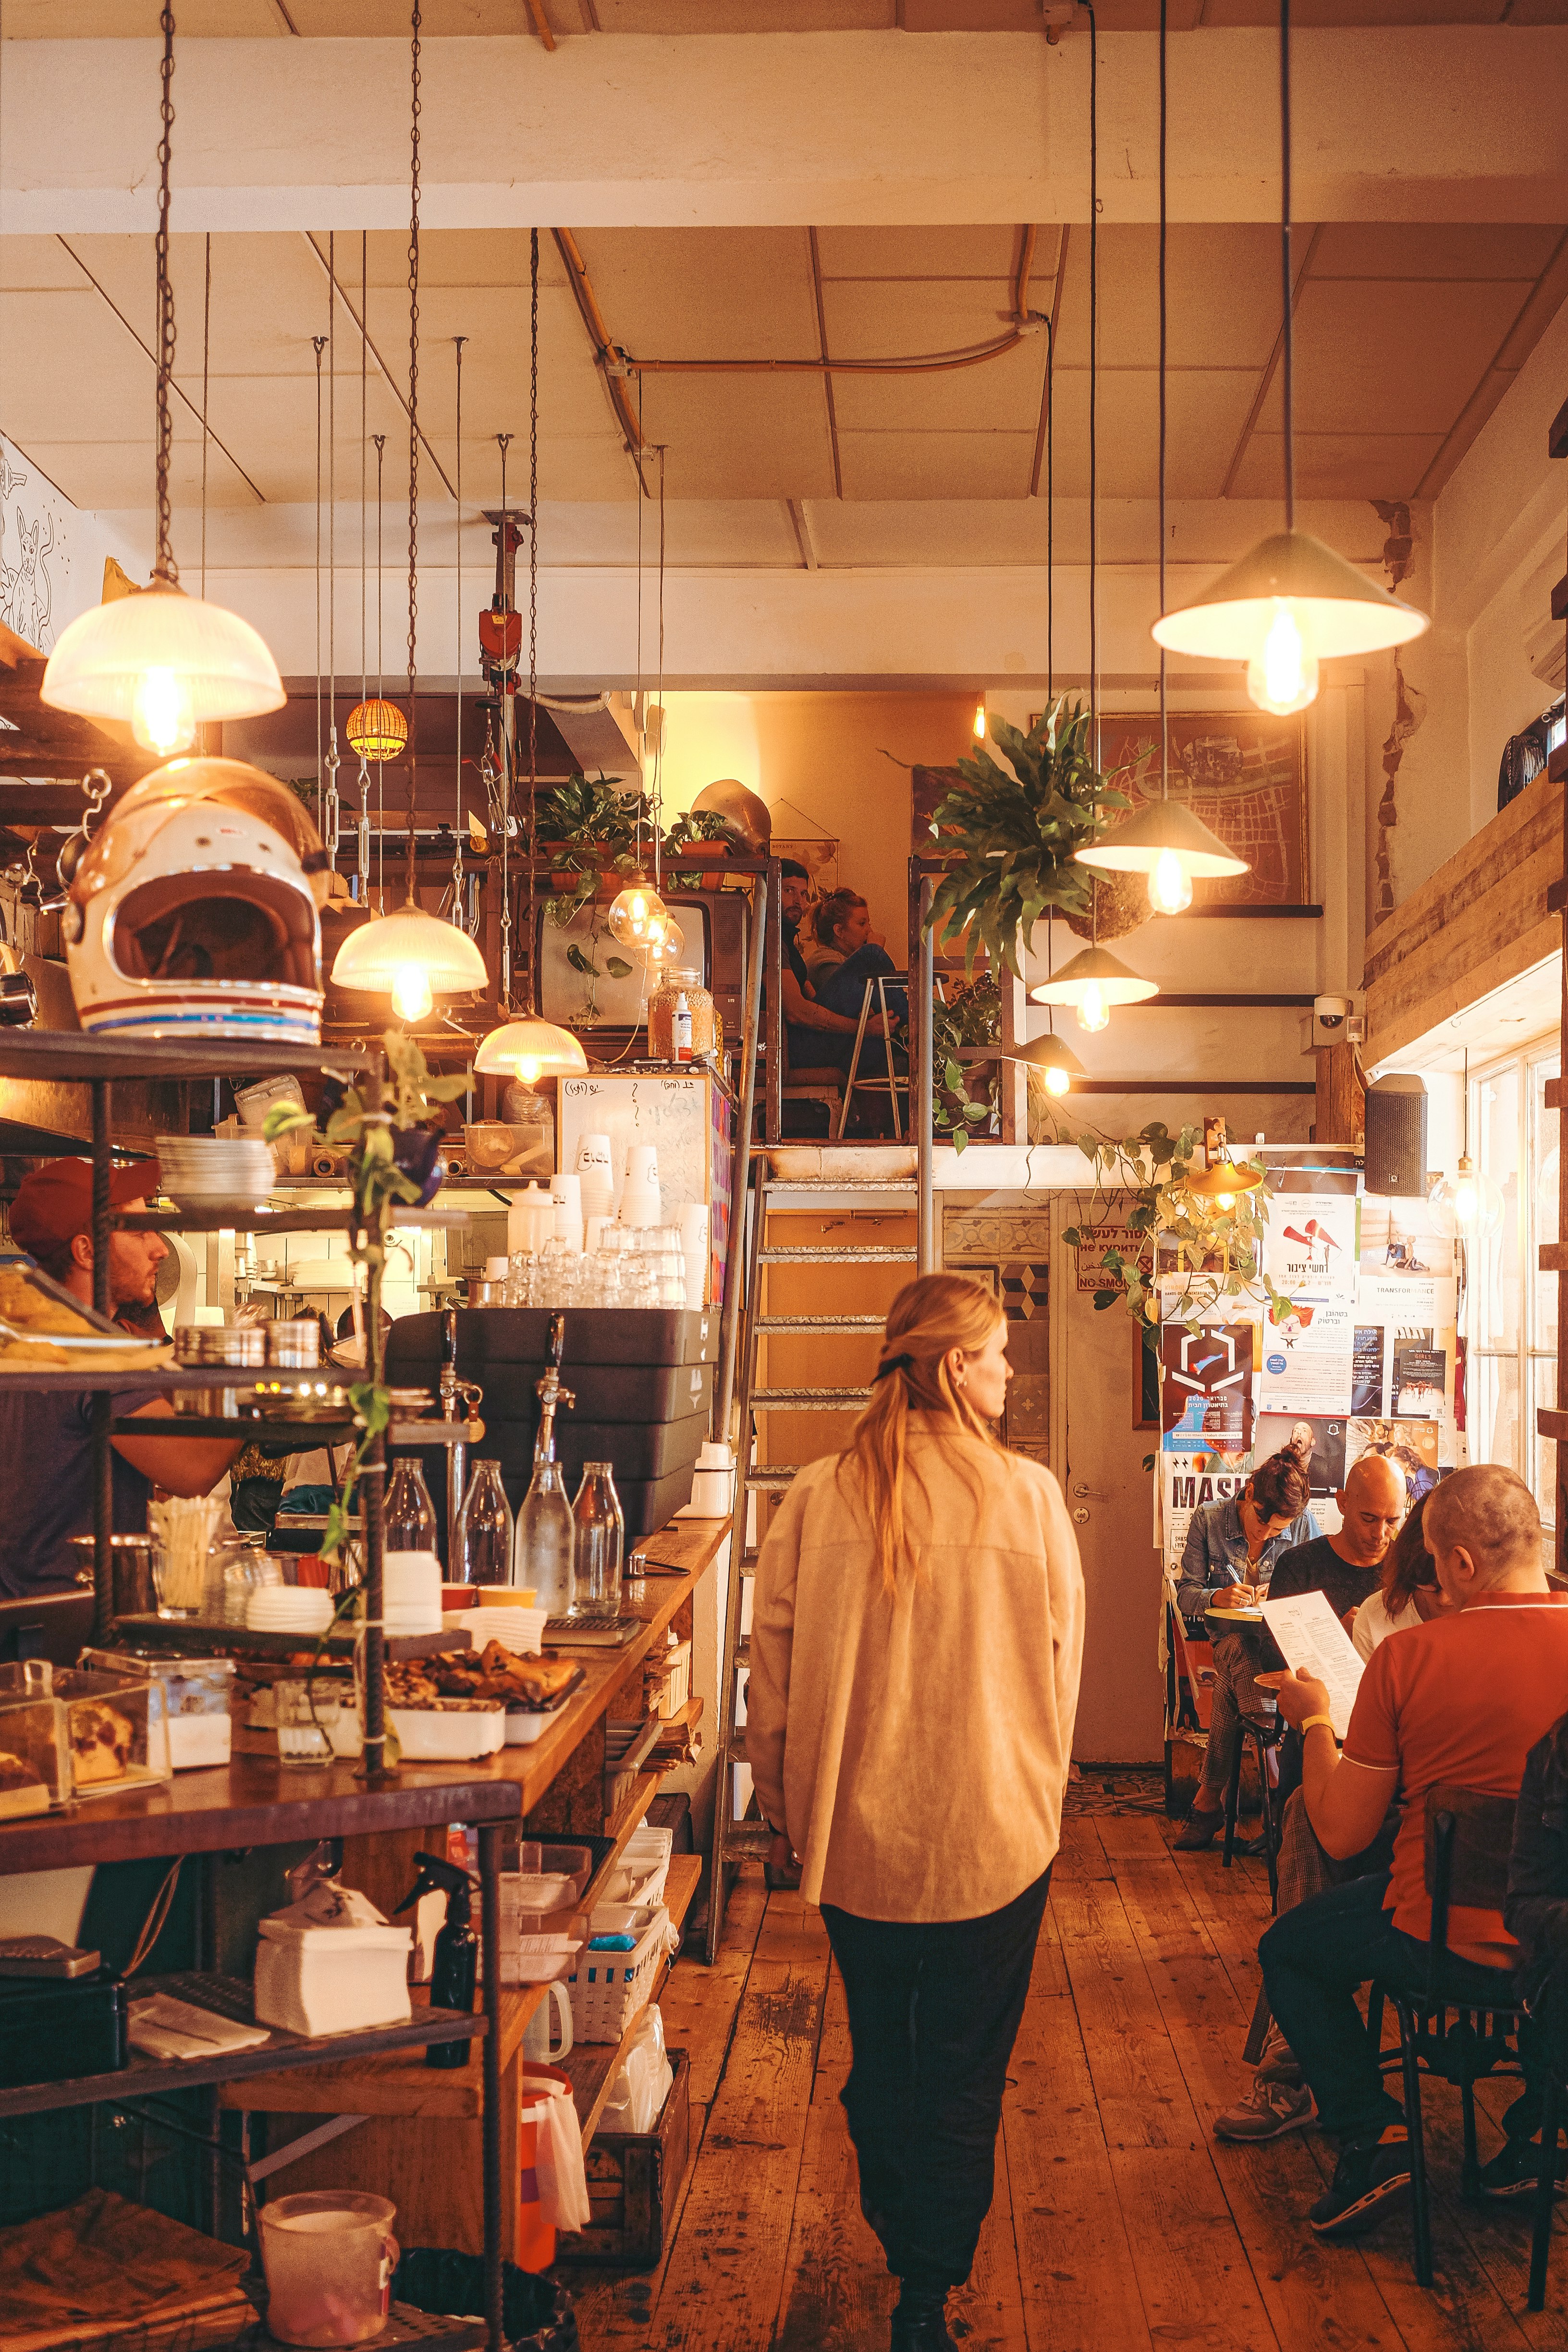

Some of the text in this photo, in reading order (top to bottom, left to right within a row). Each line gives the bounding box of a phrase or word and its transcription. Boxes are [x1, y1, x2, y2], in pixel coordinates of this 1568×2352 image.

[1287, 1264, 1328, 1273] רחשי ציבור
[1079, 1278, 1096, 1287] NO
